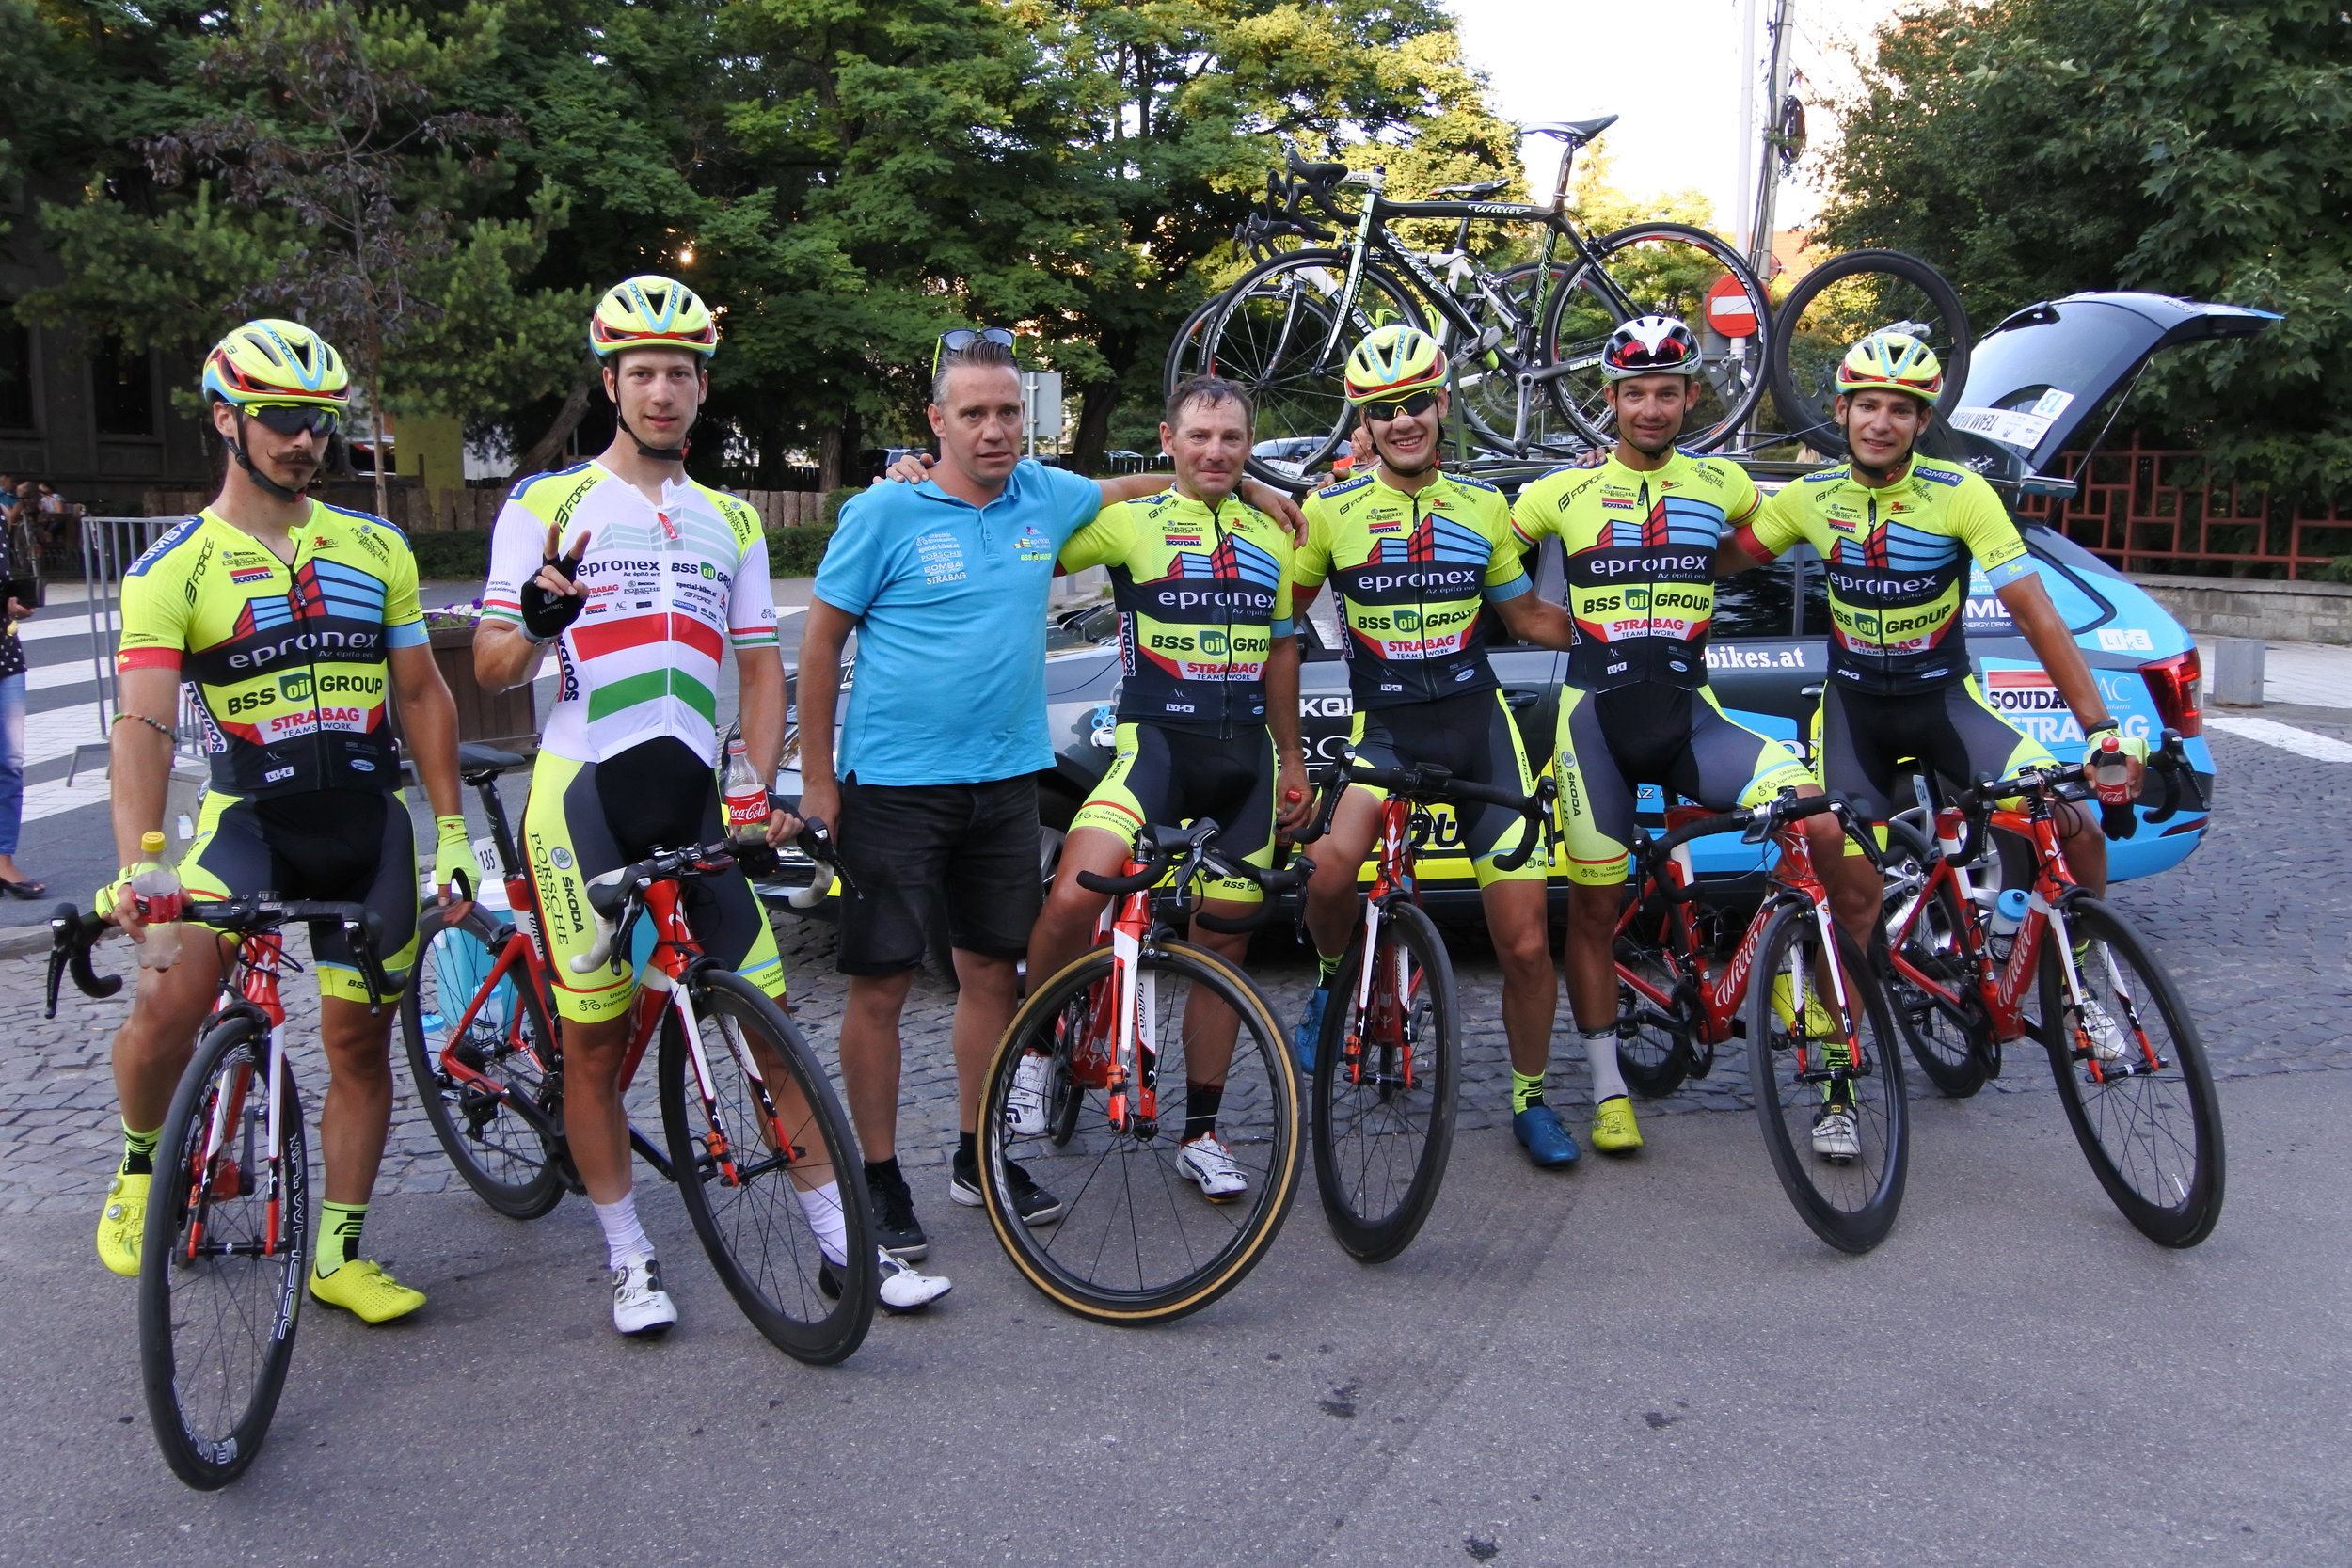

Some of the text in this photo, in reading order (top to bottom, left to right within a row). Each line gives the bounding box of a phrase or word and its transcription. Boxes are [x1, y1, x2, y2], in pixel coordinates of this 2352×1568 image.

[267, 330, 297, 362] FORCE
[1570, 358, 1601, 371] wilie
[2039, 392, 2064, 414] 13
[1320, 475, 1373, 495] BOMBA!
[1915, 467, 1963, 483] BOMBA!
[565, 476, 597, 512] FORCE
[1571, 472, 1606, 500] FORCE
[1350, 486, 1376, 508] FORCE
[1369, 526, 1402, 534] SOUDAL
[192, 537, 215, 586] FORCE
[577, 560, 660, 577] epronex
[671, 562, 699, 575] BSS
[703, 567, 714, 578] oil
[1590, 555, 1707, 577] epronex
[232, 572, 274, 585] SOUDAL
[927, 571, 967, 585] STRABAG
[1358, 570, 1475, 593] epronex
[1830, 571, 1937, 594] epronex
[588, 584, 619, 594] TRABAG
[1158, 592, 1277, 610] epronex
[1583, 593, 1710, 614] BSS oil GROUP
[1358, 616, 1391, 630] BSS
[1398, 616, 1418, 629] oil
[1613, 618, 1685, 633] STRABAG
[1859, 620, 1877, 635] oil
[1885, 604, 1952, 634] GROUP
[1151, 634, 1195, 651] BSS
[1205, 638, 1226, 652] oil
[1389, 635, 1455, 653] STRABAG
[1621, 629, 1648, 638] TEAMS
[229, 631, 378, 669] epronex
[1706, 646, 1805, 669] bikes.at
[1187, 663, 1259, 673] STRABAG
[227, 675, 383, 716] BSS oil GROUP
[1989, 691, 2071, 710] SOUDA
[184, 682, 225, 752] SOUDAL
[271, 707, 360, 732] STRABAG
[282, 723, 318, 738] TEAMS
[1566, 771, 1581, 817] ŠKODA
[479, 849, 496, 873] 135
[530, 832, 569, 945] PORSCHE
[533, 863, 550, 911] BUDA
[1222, 880, 1247, 890] BSS
[562, 876, 585, 934] ŠKODA
[1997, 909, 2033, 1008] Wilier
[347, 978, 368, 990] BS
